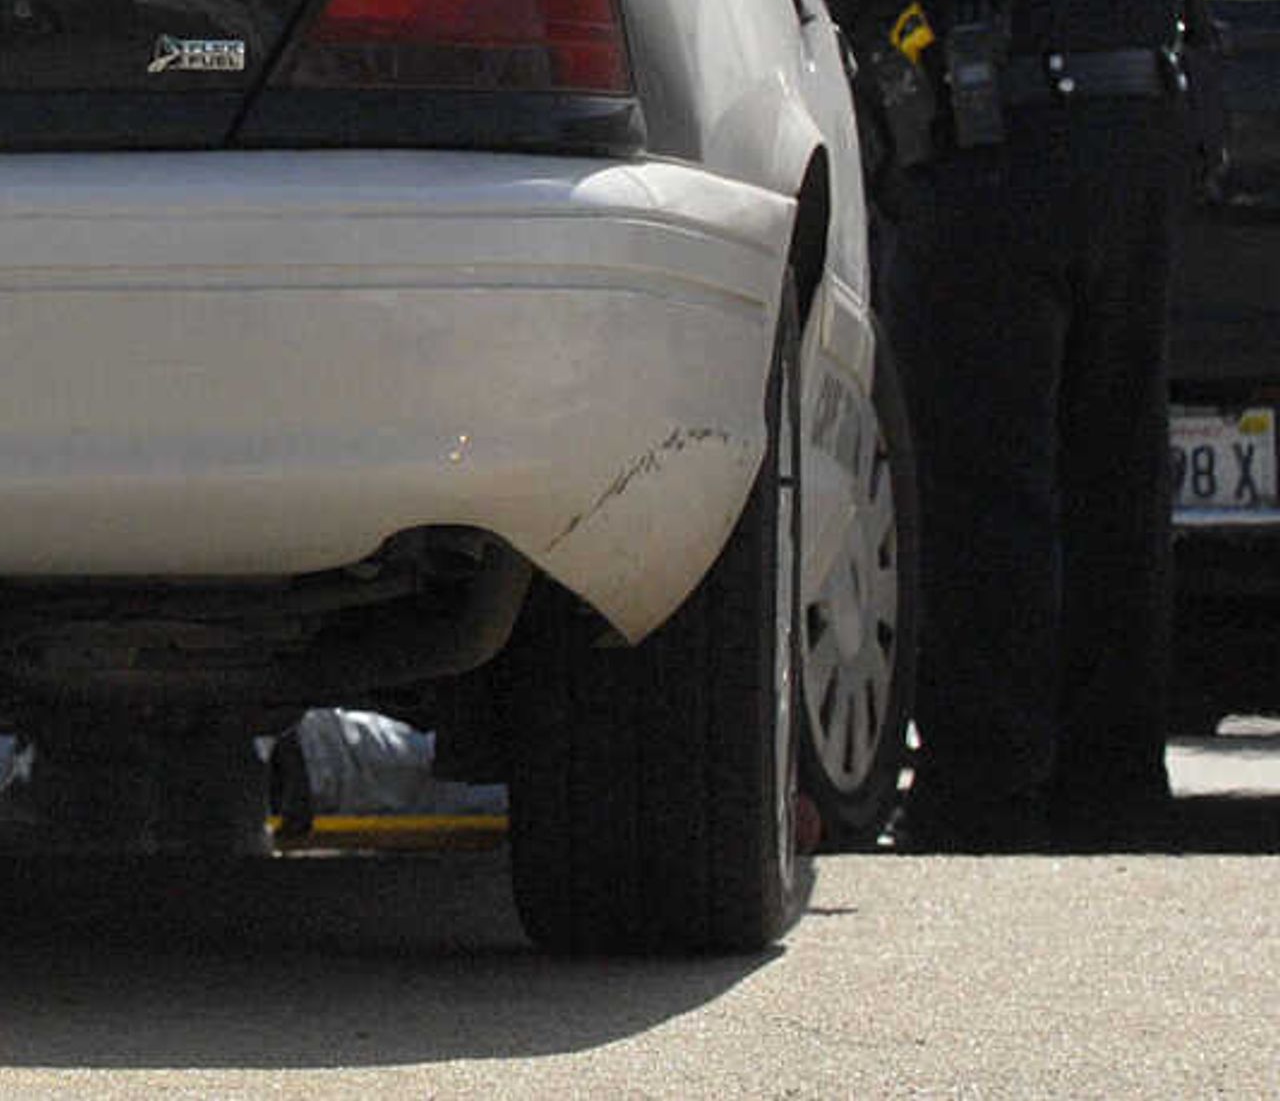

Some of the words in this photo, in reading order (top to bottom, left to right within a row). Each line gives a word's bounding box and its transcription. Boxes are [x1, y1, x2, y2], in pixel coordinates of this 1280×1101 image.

[182, 39, 244, 53] FLEX
[185, 52, 243, 69] FUEL
[1231, 442, 1258, 508] X
